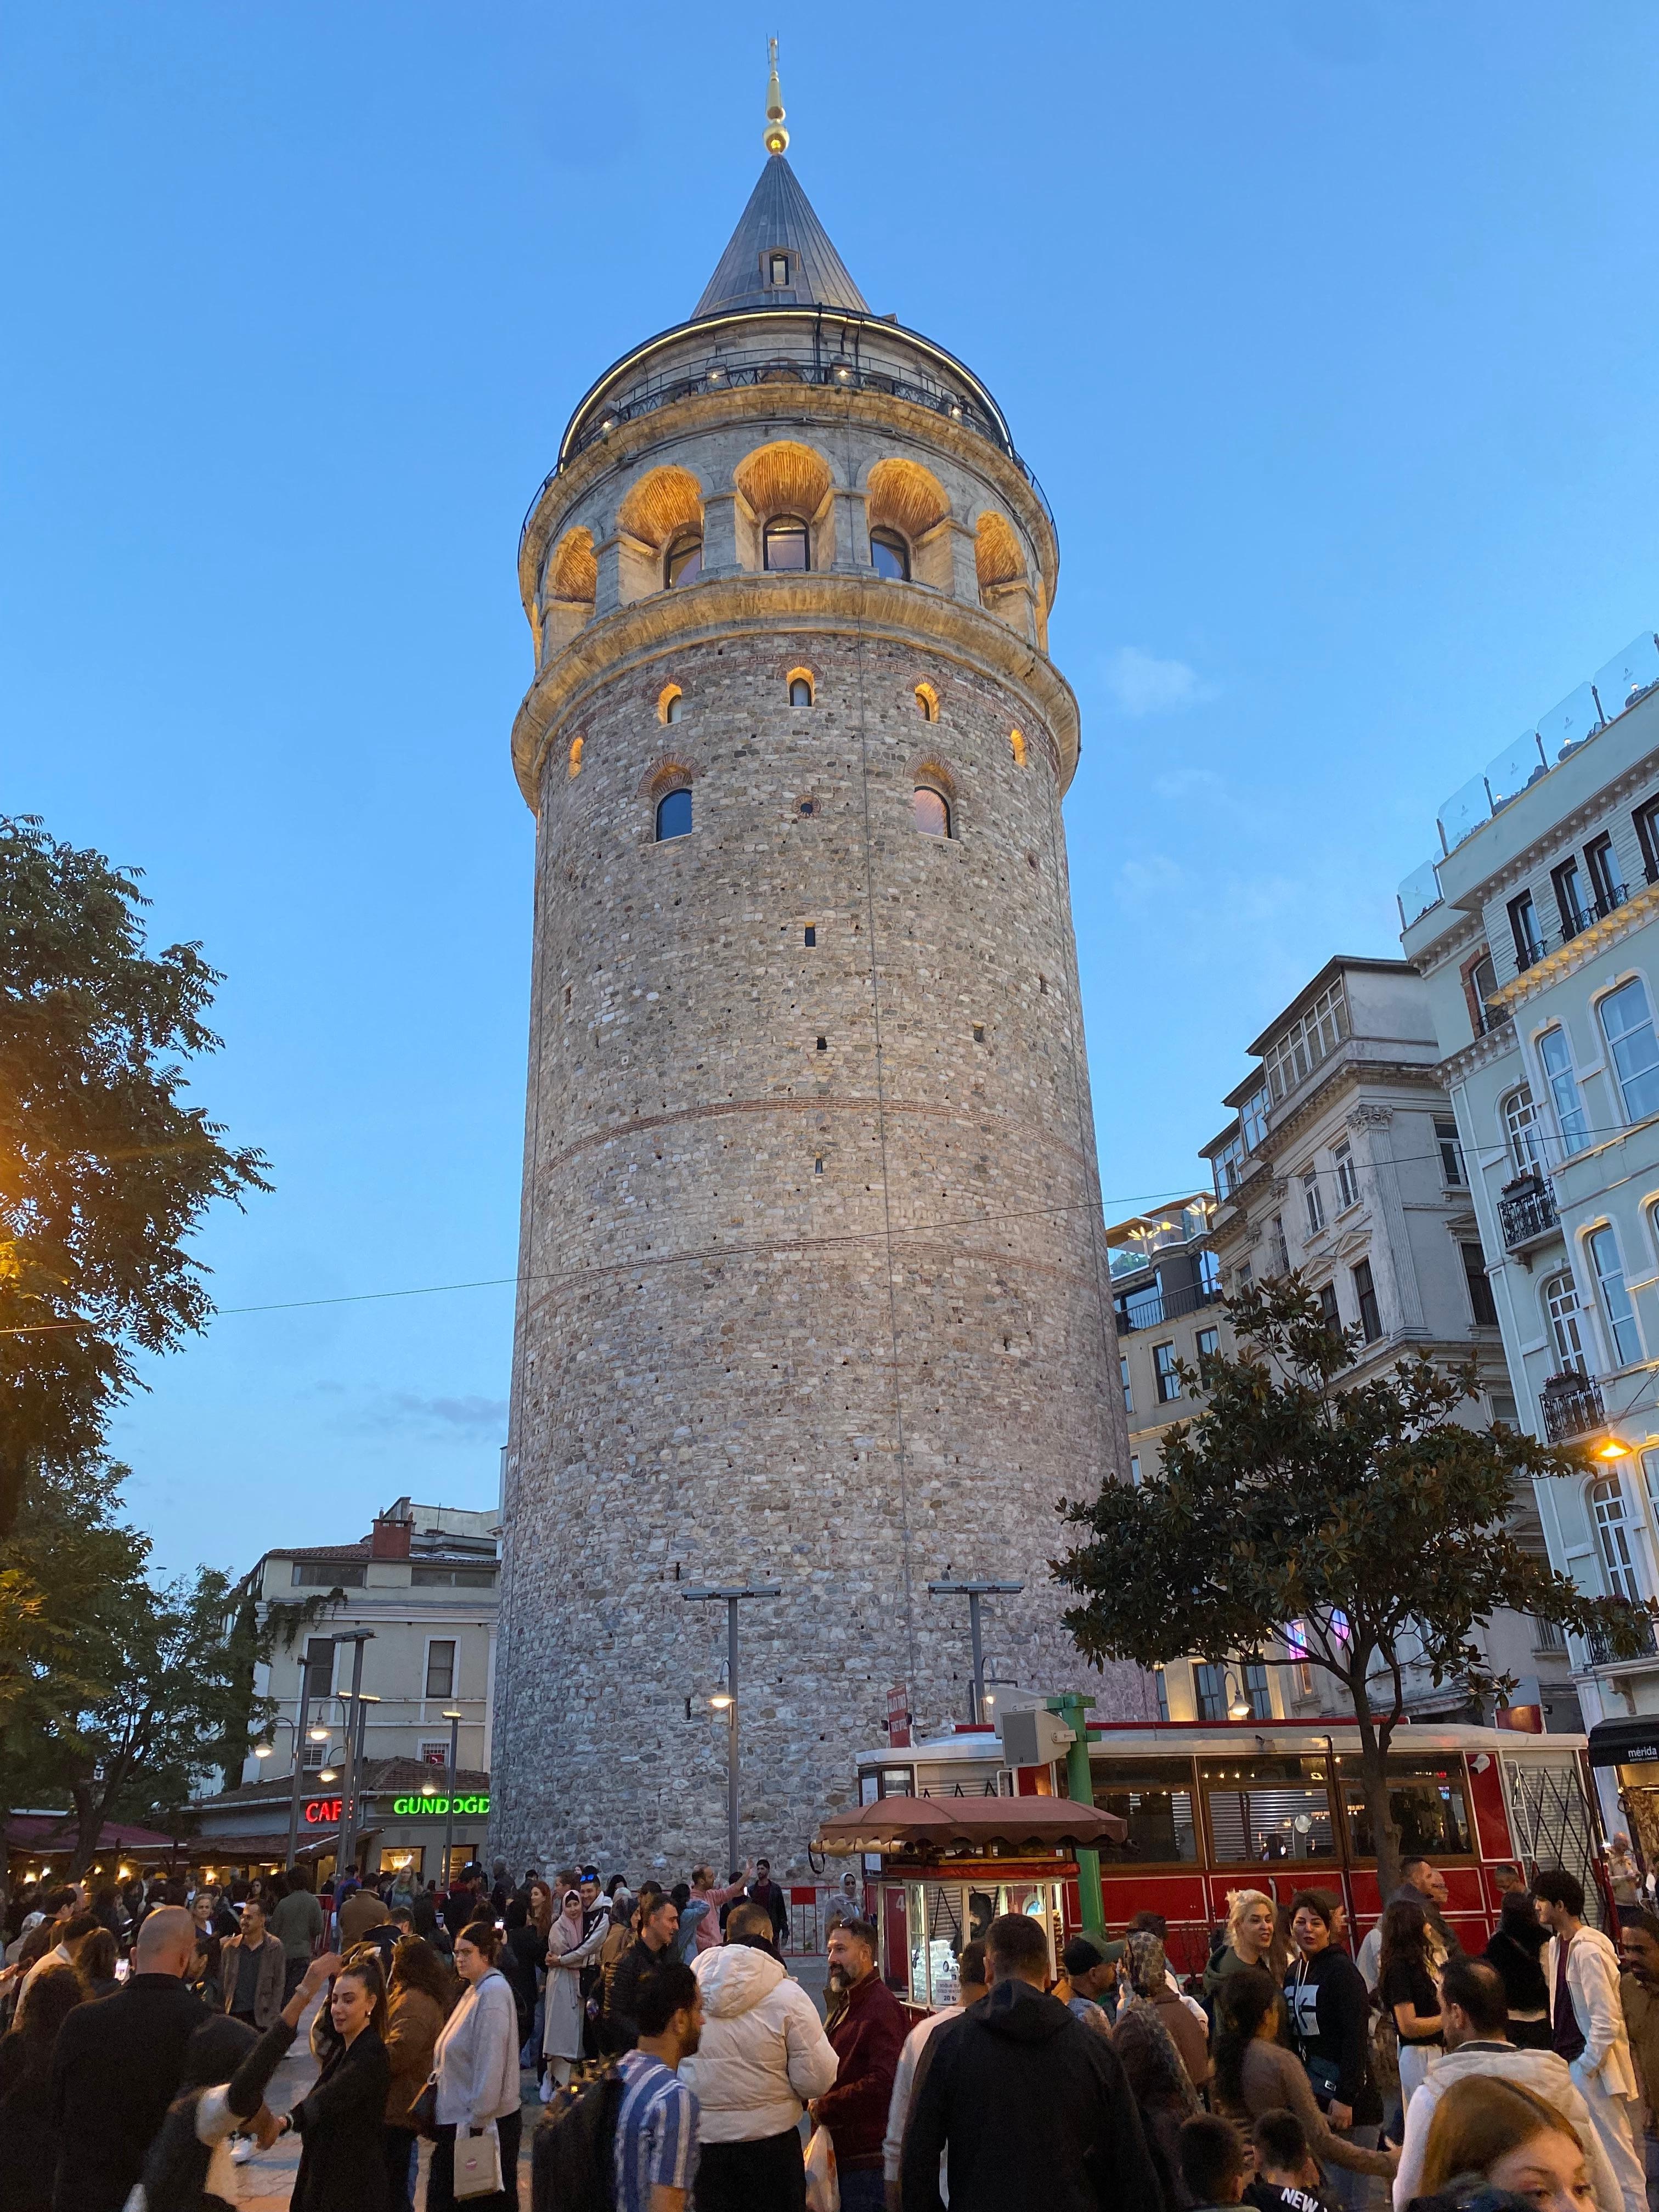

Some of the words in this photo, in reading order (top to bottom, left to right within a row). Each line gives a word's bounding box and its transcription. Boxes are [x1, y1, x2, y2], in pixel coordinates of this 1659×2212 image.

[1628, 1746, 1657, 1758] mérida
[895, 1895, 905, 1912] 4
[1280, 2187, 1319, 2212] NEW
